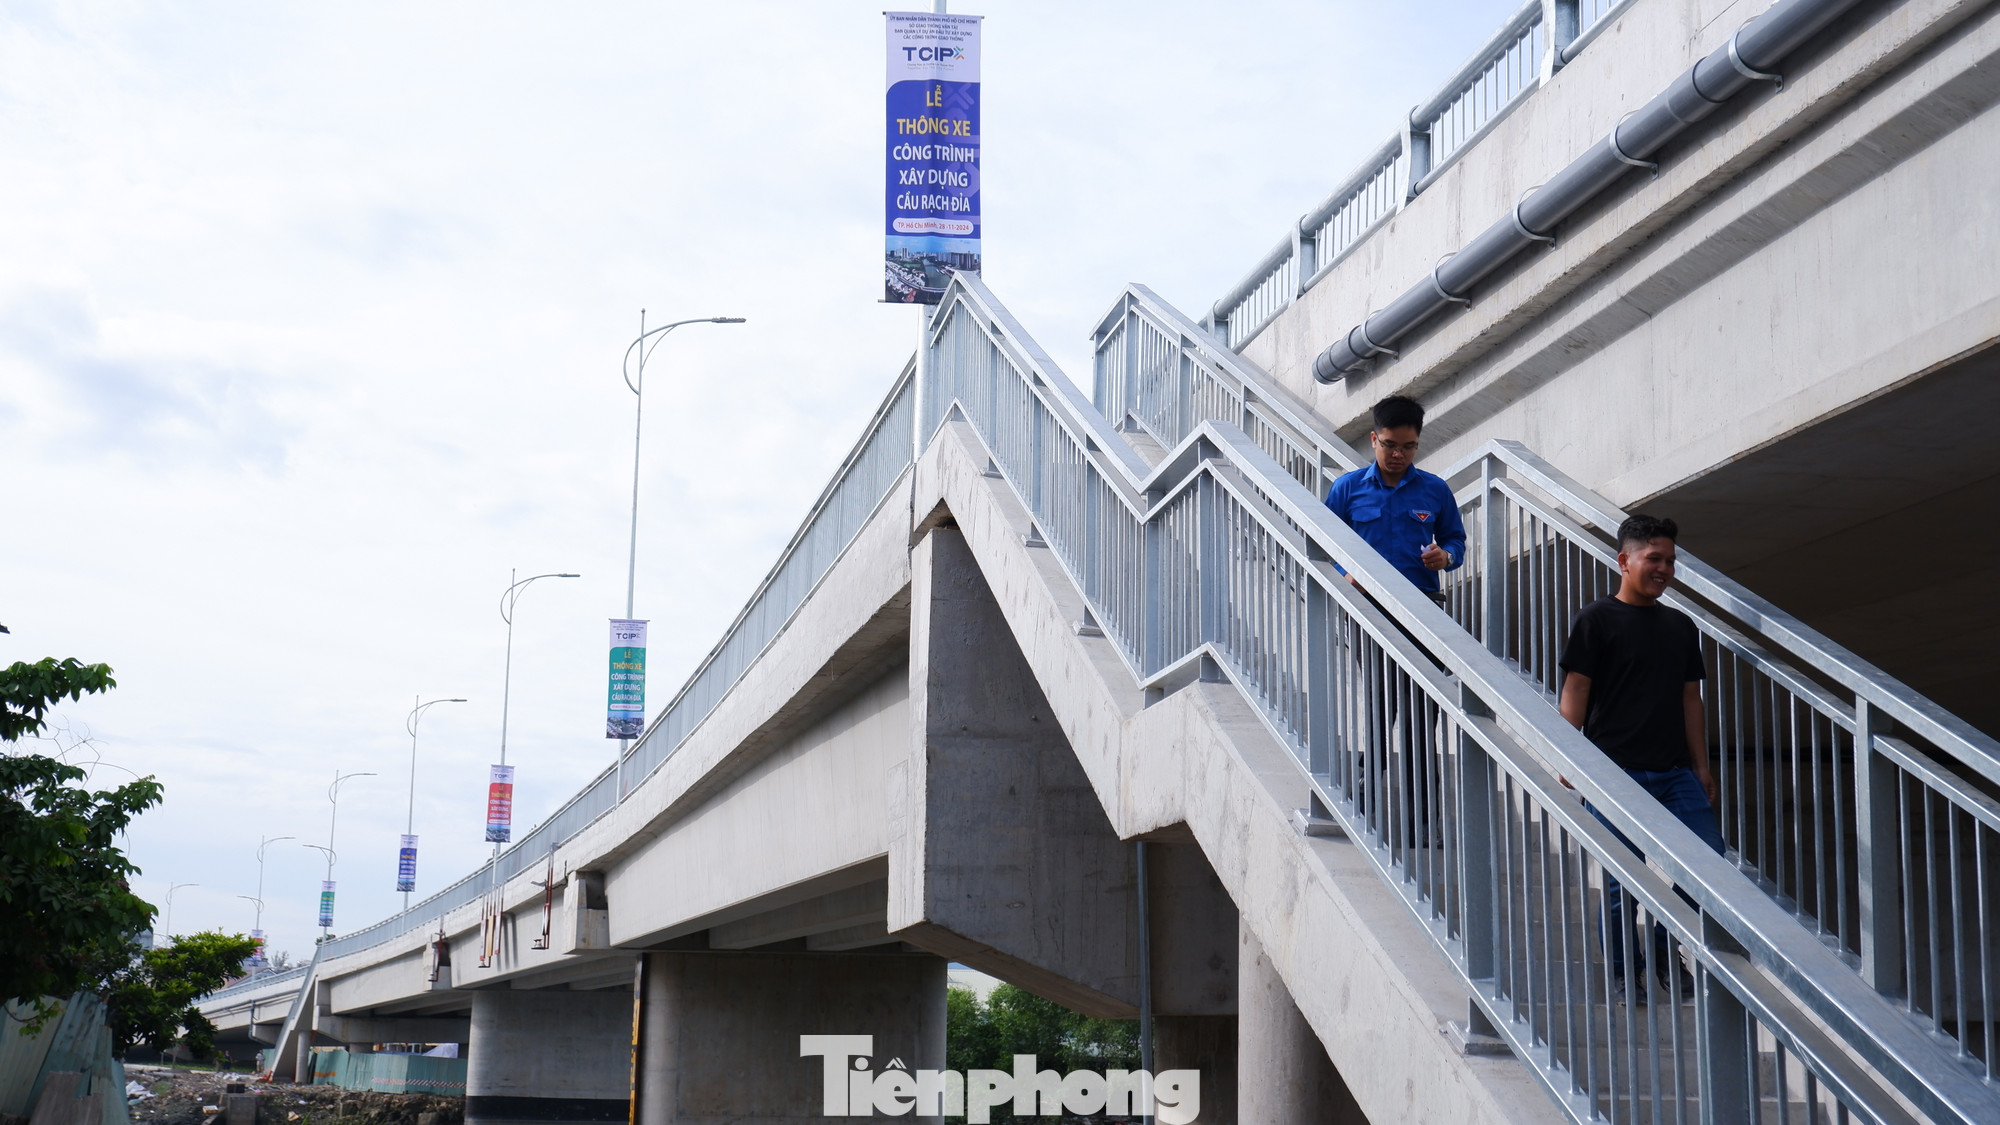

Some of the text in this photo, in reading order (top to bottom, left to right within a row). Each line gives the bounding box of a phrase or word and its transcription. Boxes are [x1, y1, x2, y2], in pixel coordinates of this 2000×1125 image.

[902, 46, 954, 61] TCIP
[926, 85, 942, 107] LỄ
[897, 115, 971, 136] THÔNG XE
[893, 142, 974, 162] CÔNG TRÌNH
[899, 168, 968, 189] XÂY DỰNG
[897, 191, 970, 213] CẦU RẠCH ĐỈA
